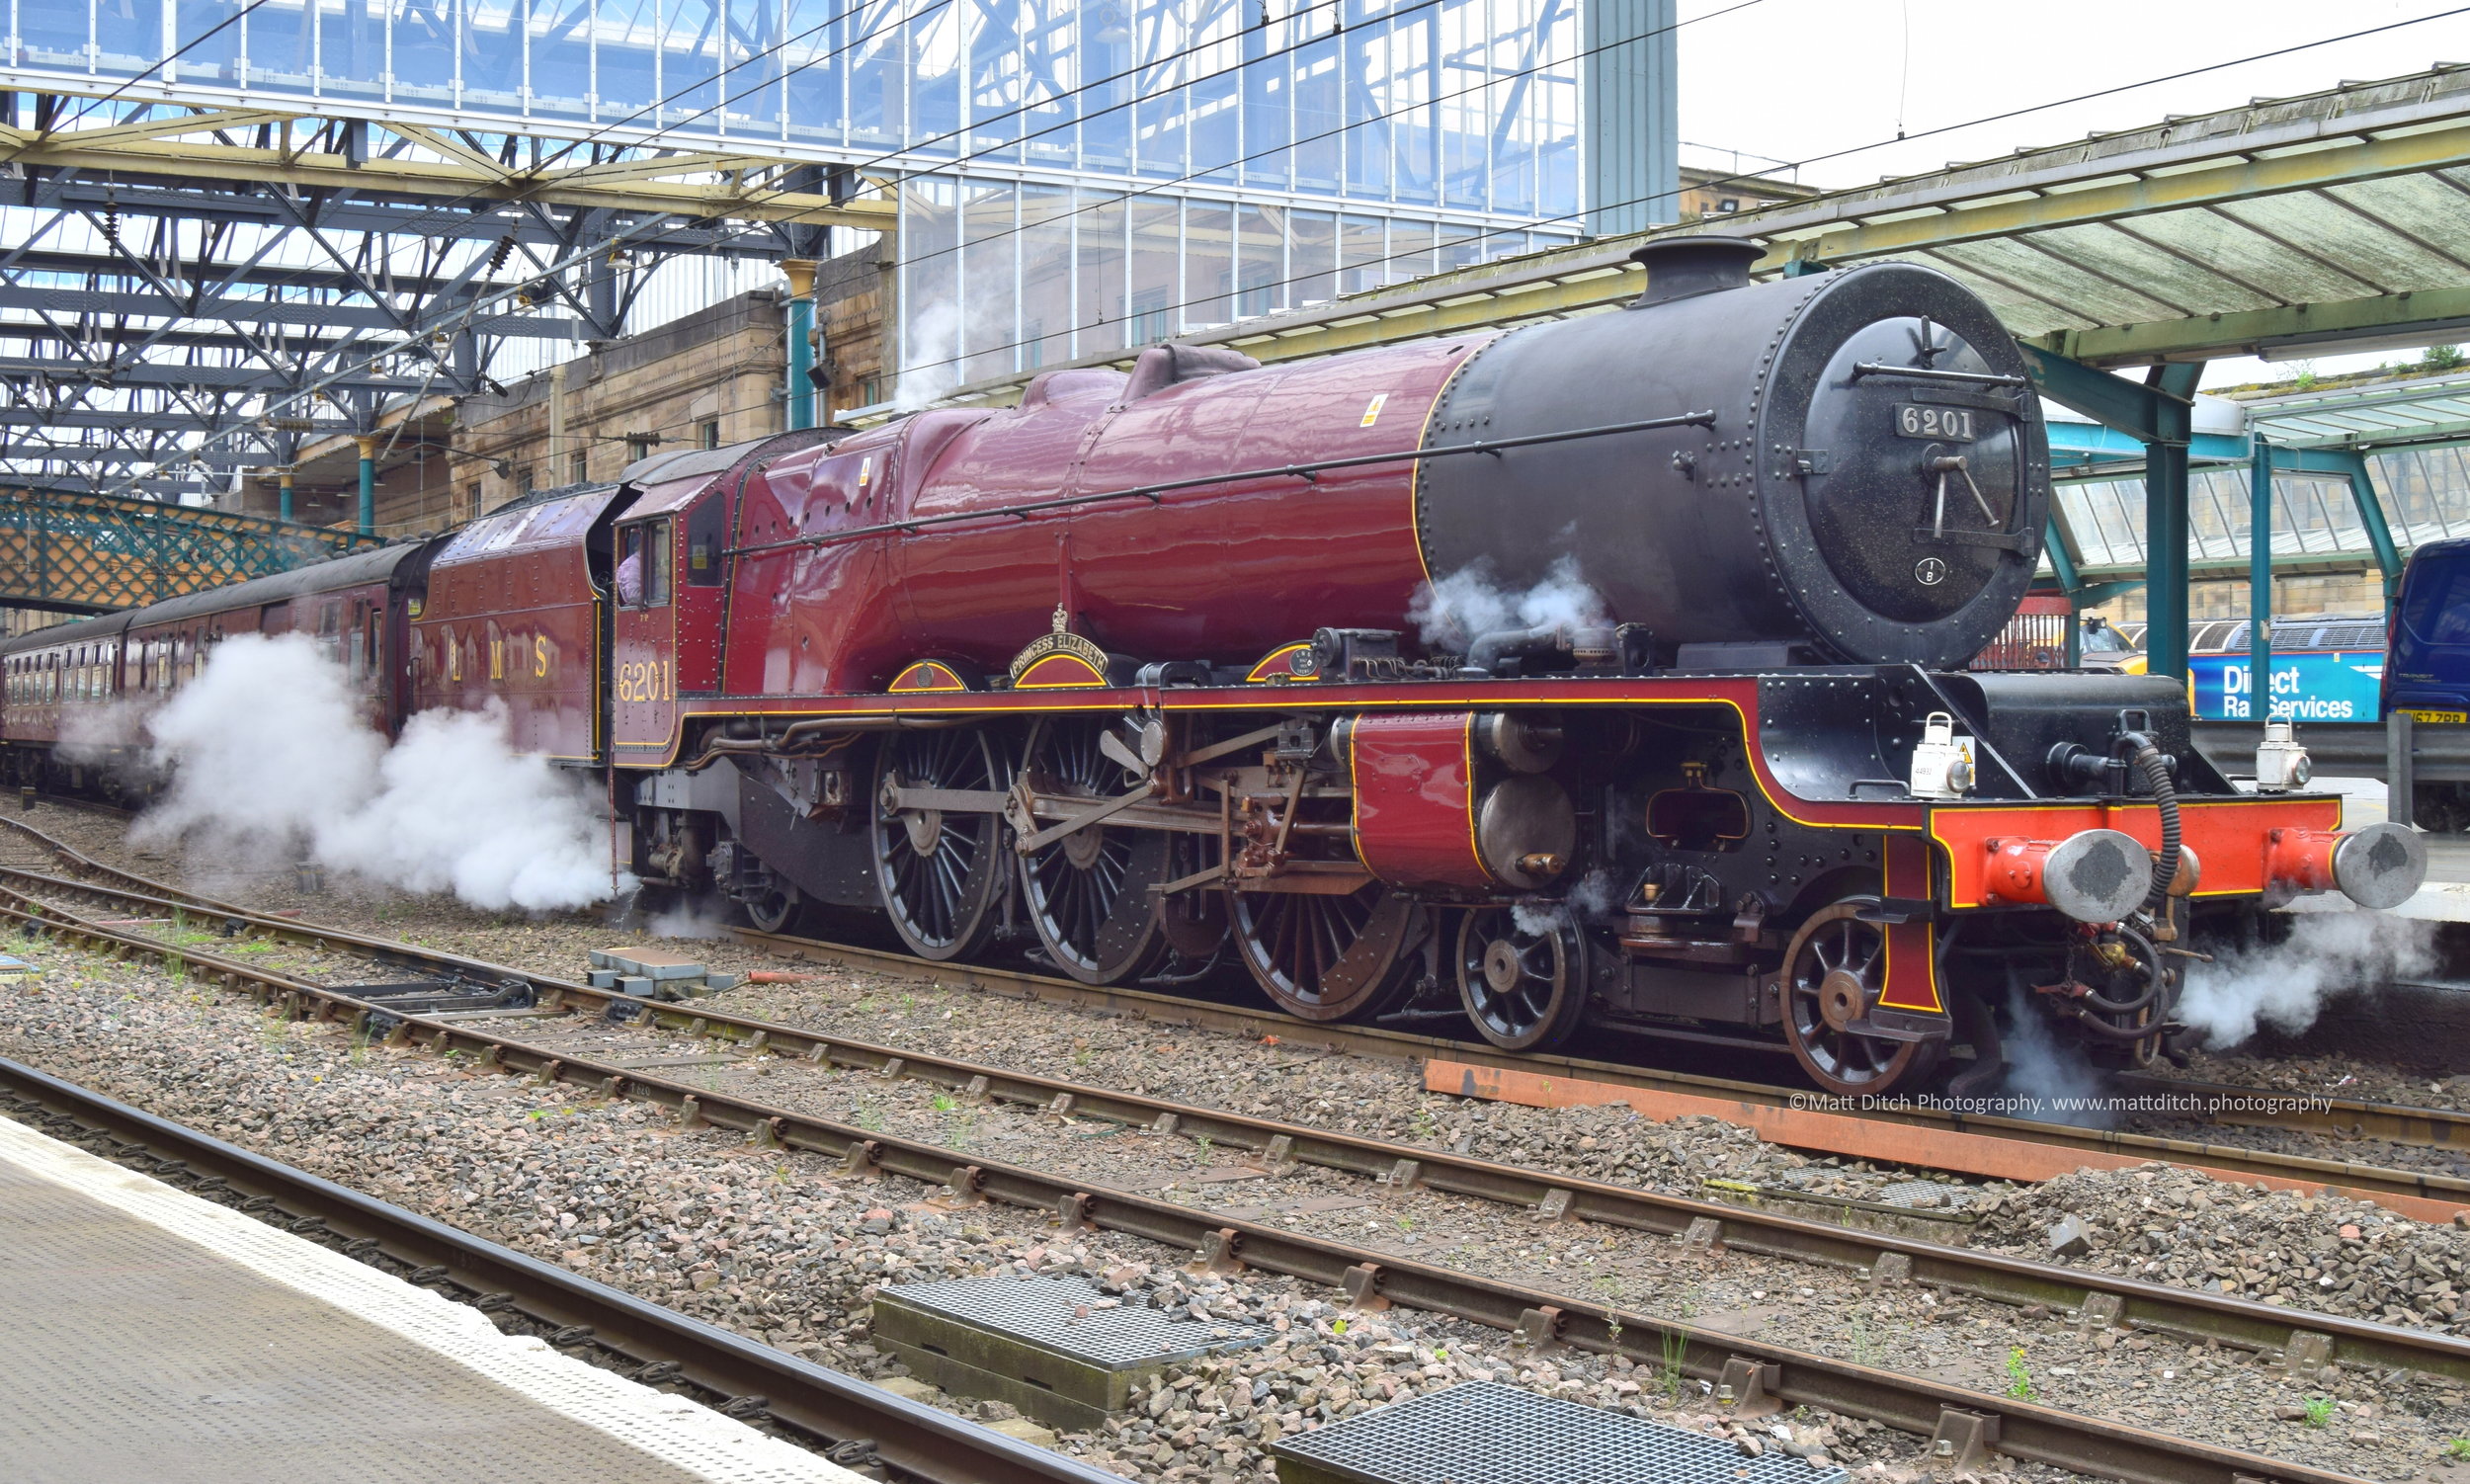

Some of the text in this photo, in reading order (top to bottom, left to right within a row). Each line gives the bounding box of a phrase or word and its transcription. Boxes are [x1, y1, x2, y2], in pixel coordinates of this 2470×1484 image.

[1902, 407, 1973, 439] 6201
[1012, 634, 1106, 675] PRINCESS ELIZABETH
[618, 660, 670, 701] 6201
[2224, 665, 2300, 694] Dict
[2224, 695, 2353, 718] Ra Services
